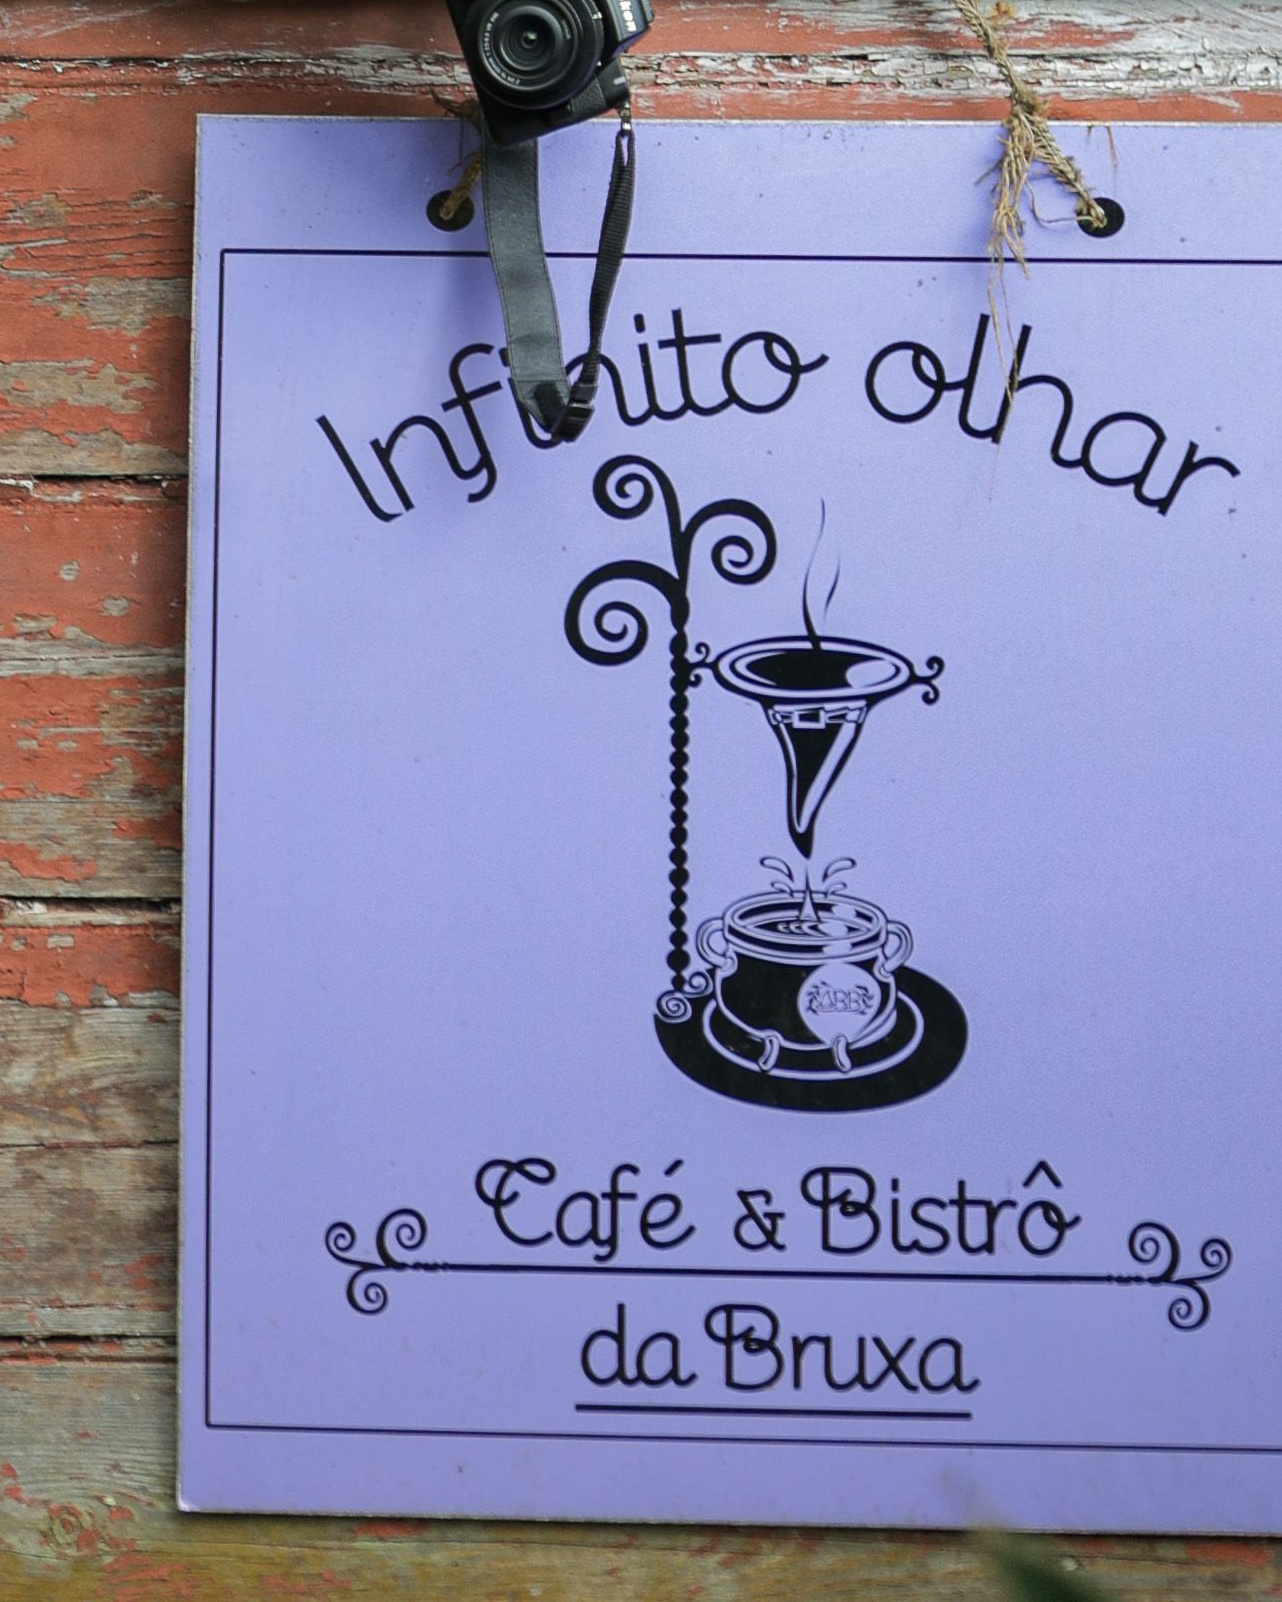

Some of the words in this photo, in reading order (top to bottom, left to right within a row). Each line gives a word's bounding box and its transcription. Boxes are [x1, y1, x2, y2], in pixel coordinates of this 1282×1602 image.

[316, 308, 828, 522] Infinito
[863, 312, 1242, 518] olhar
[475, 1157, 697, 1263] Café
[732, 1188, 786, 1252] &
[800, 1160, 1082, 1258] Bistrô
[579, 1303, 698, 1388] da
[703, 1303, 982, 1394] Bruxa
